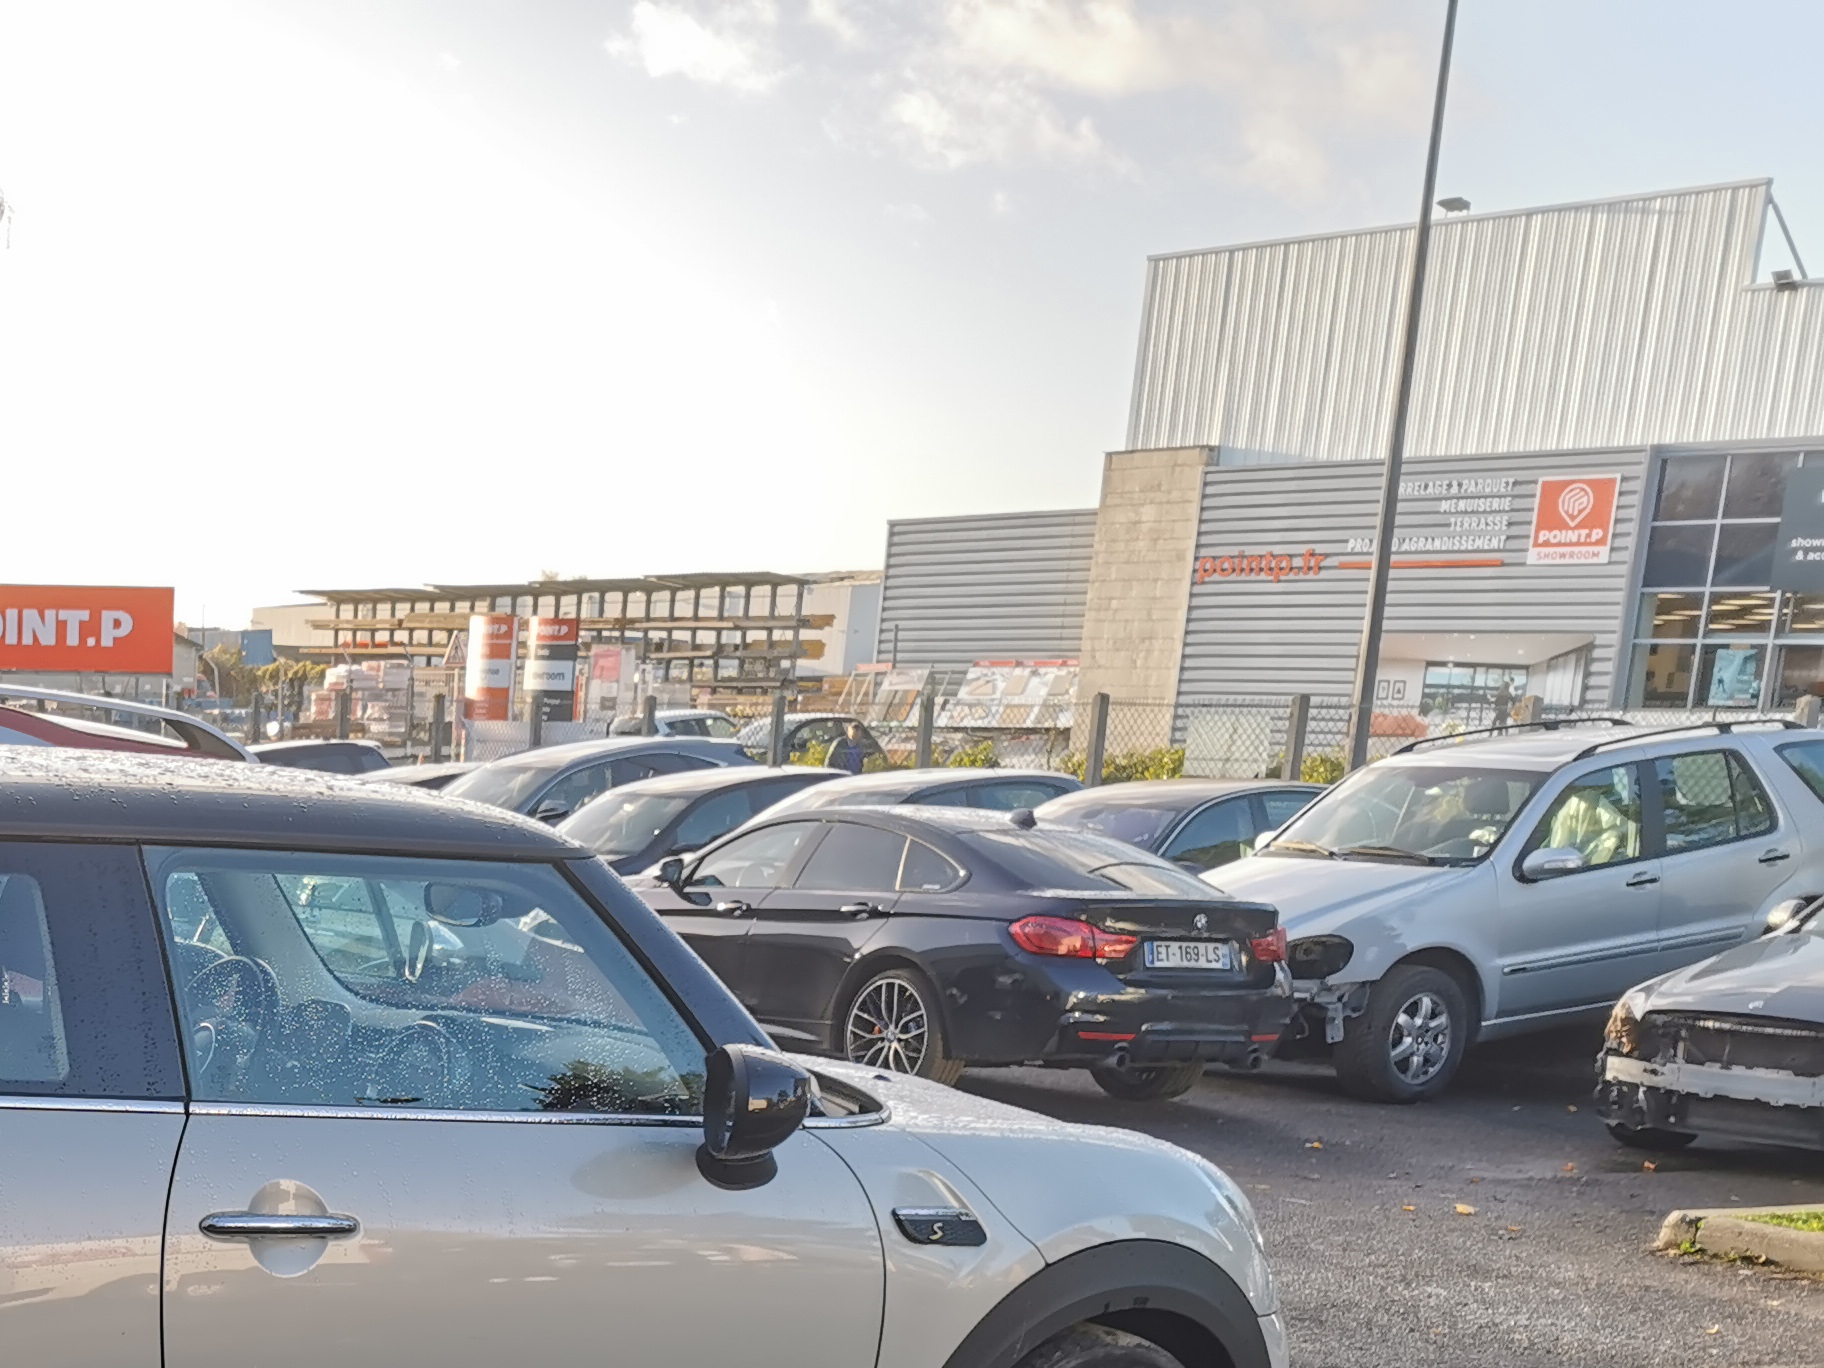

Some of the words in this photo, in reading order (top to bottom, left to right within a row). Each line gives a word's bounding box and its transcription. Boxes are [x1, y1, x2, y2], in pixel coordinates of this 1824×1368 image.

[1398, 481, 1450, 496] RRELAGE
[1461, 478, 1516, 494] PARQUET
[1440, 497, 1513, 513] MENUISERIE
[1449, 516, 1510, 531] TERRASSE
[1347, 538, 1377, 552] PROJ
[1391, 535, 1507, 551] D'AGRANDISSEMENT
[1537, 528, 1604, 544] POINT.P
[1536, 550, 1600, 561] SHOWROOM
[1197, 548, 1326, 585] pointp.fr
[1155, 944, 1221, 964] ET-169-LS
